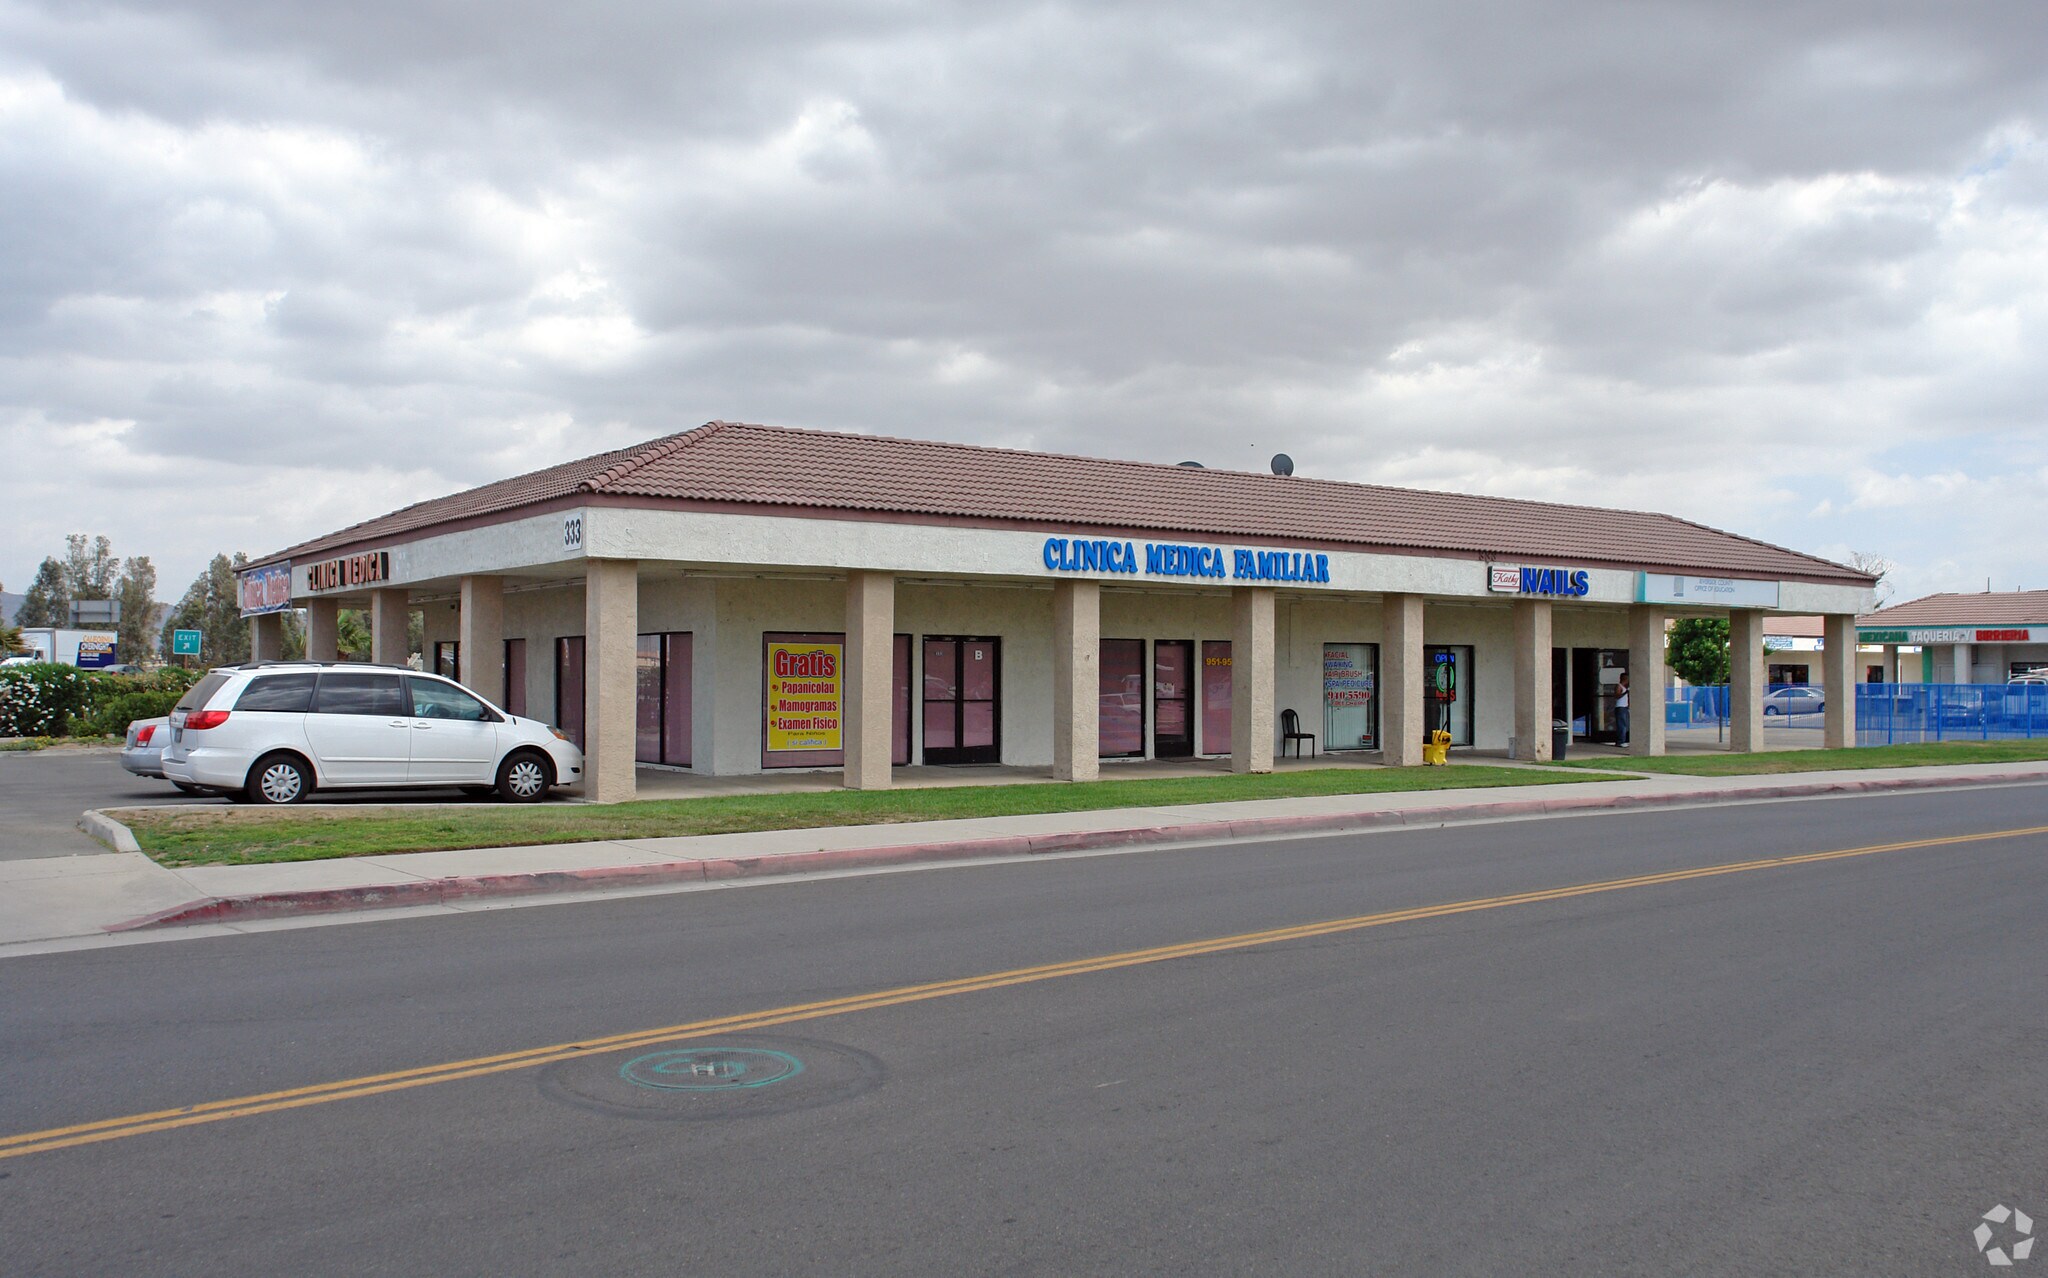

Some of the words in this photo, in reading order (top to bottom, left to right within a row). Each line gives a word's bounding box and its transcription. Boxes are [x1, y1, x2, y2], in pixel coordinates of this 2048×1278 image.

[564, 518, 581, 546] 333
[307, 560, 340, 591] CLINICA
[343, 551, 383, 585] MEDICA
[1043, 538, 1138, 572] CLINICA
[1145, 543, 1226, 577] MEDICA
[1233, 549, 1330, 583] FAMILIAR
[1492, 571, 1523, 586] Kathy
[1522, 567, 1588, 596] NAILS
[1975, 629, 2029, 641] BIRRIERIA
[774, 649, 837, 678] Gratis
[975, 650, 983, 661] B
[781, 681, 835, 695] Papanicolau
[779, 699, 837, 713] Mamogramas
[778, 717, 811, 730] Examen
